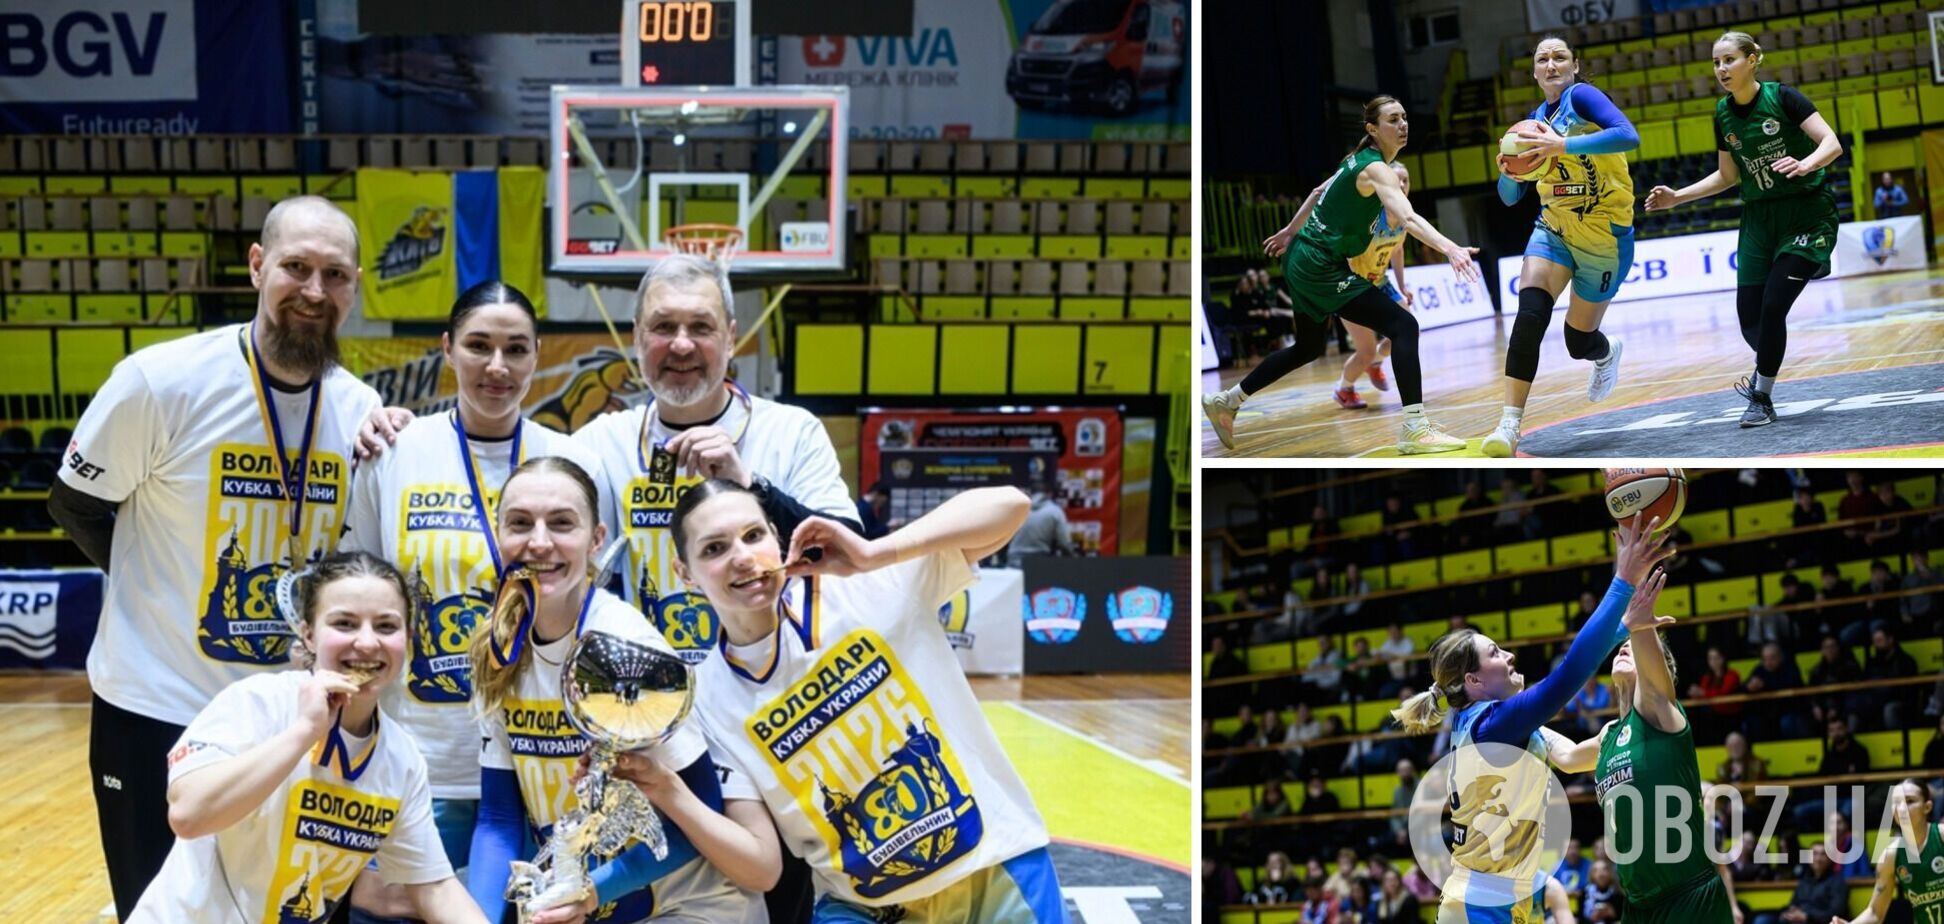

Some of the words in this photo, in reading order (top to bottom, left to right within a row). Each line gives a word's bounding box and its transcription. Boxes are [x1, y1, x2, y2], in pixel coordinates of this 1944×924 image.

[1561, 0, 1615, 26] ФБУ
[0, 11, 167, 78] BGV
[856, 28, 959, 66] VIVA
[301, 19, 319, 137] СЕКТОР
[805, 71, 891, 87] МЕРЕЖА
[897, 71, 959, 87] КЛІНІК
[63, 112, 199, 135] Futuready
[1554, 185, 1585, 195] GGBET
[1600, 271, 1612, 293] 8
[363, 346, 443, 408] ВІЙ
[1093, 360, 1109, 385] 7
[222, 452, 339, 480] ВОЛДАРІ
[223, 480, 273, 496] КУБКА
[277, 482, 336, 501] УКАЇНИ
[1621, 489, 1642, 505] FBU
[408, 515, 455, 529] КУБКА
[243, 574, 276, 620] 8
[752, 637, 876, 742] ВОЛОДАРІ
[504, 708, 573, 735] ВОЛОДА
[773, 716, 824, 759] КУБКА
[821, 660, 888, 717] УКРАЇНИ
[786, 676, 927, 812] 2026
[863, 765, 931, 841] 80
[872, 810, 952, 865] БУДІВЕЛЬНИК
